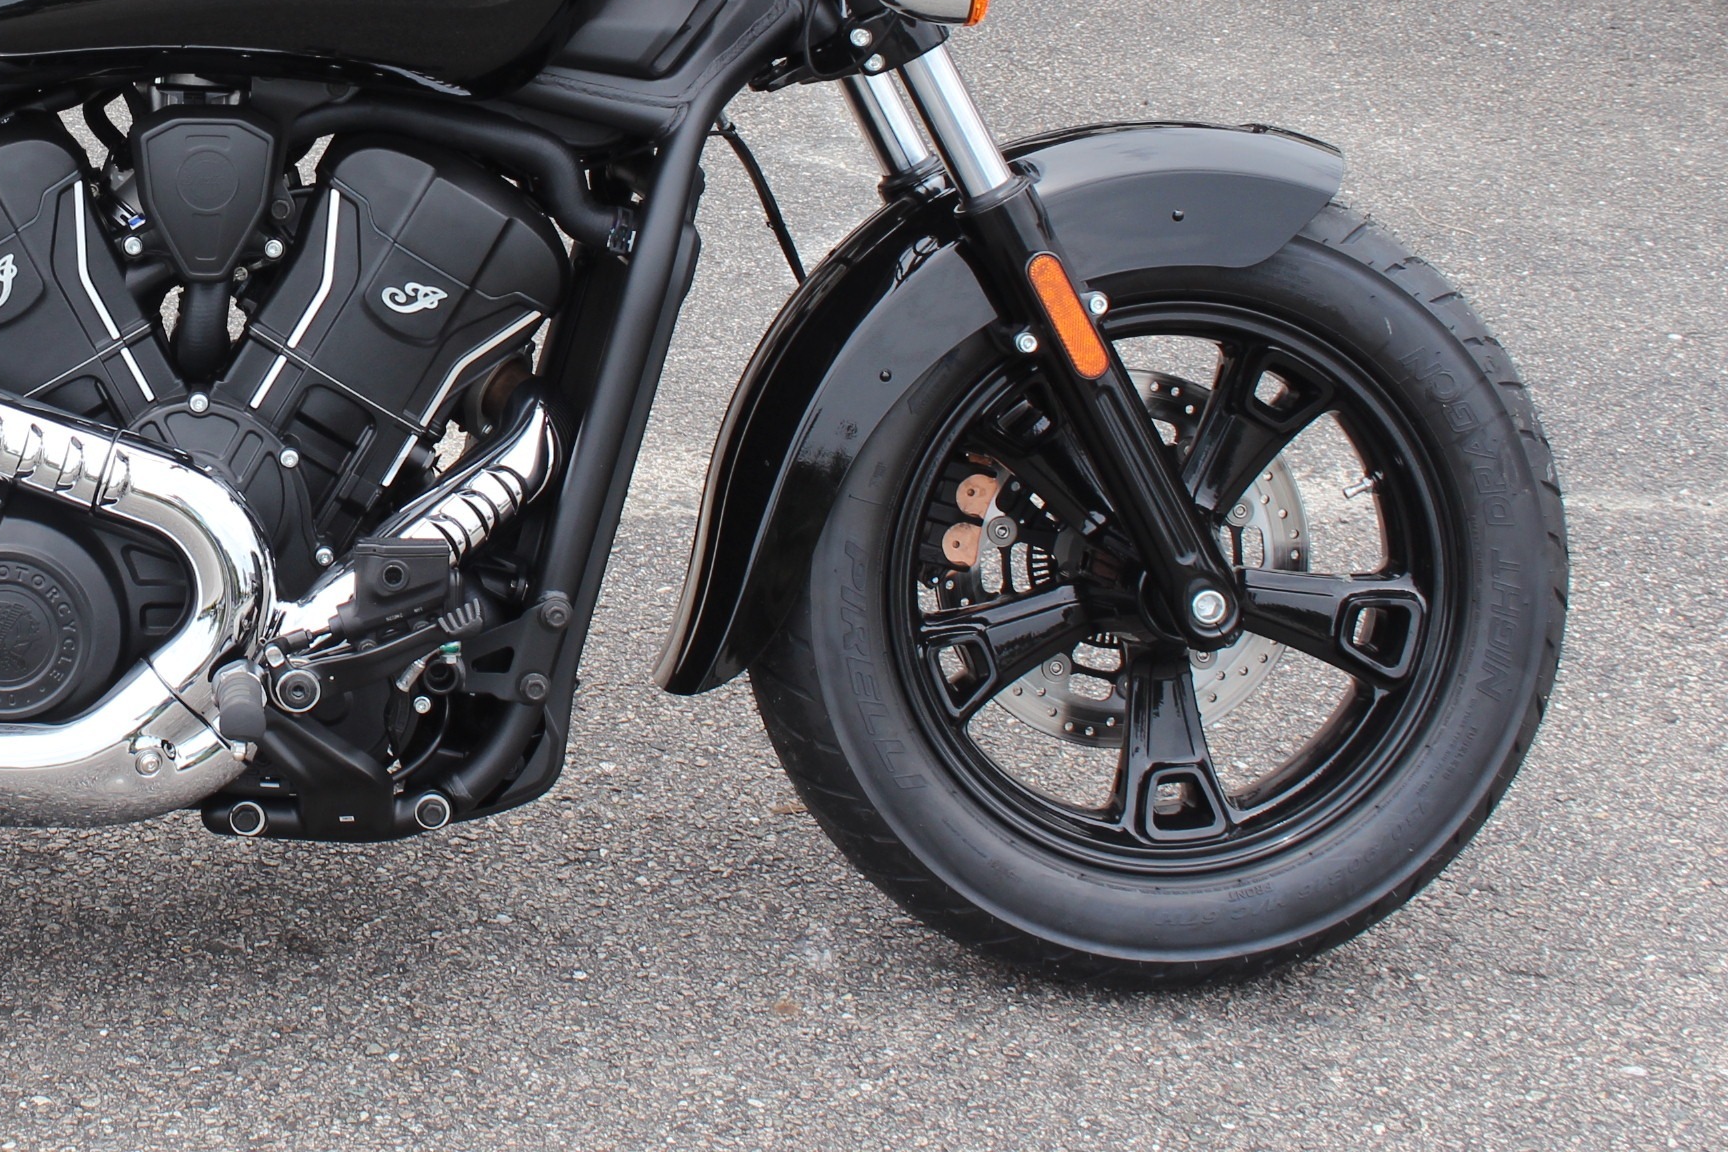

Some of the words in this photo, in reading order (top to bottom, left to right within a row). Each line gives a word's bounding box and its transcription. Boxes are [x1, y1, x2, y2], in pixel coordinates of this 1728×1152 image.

[1399, 344, 1518, 529] DRAGON
[840, 540, 928, 791] PIRELLI
[1475, 547, 1523, 701] NIGHT
